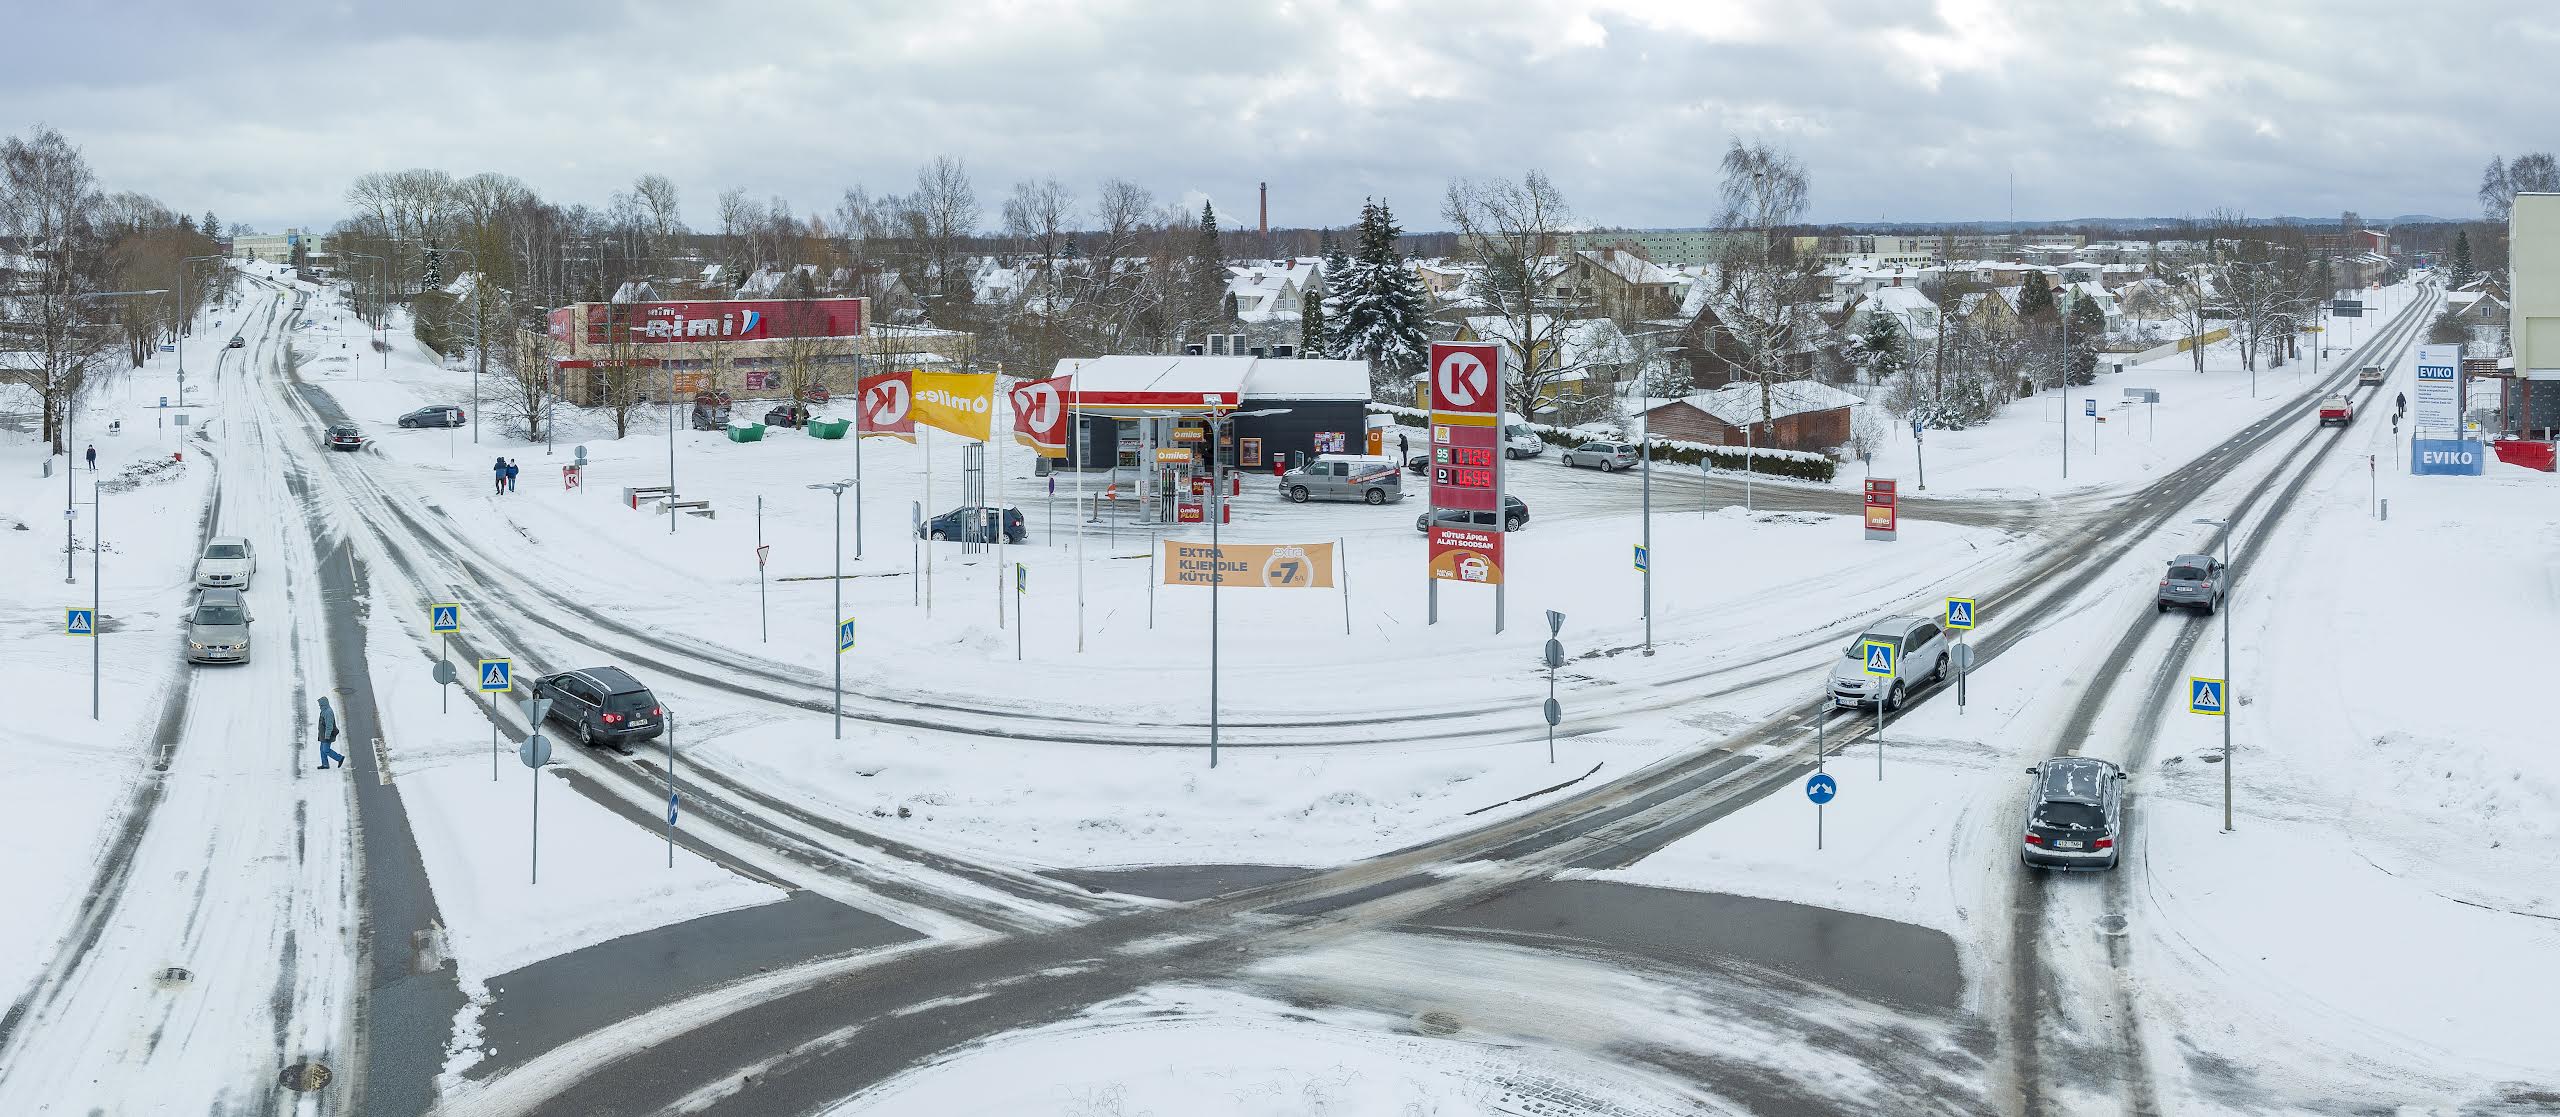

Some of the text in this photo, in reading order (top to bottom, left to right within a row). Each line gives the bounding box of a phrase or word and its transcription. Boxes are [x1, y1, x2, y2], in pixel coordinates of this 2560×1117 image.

[2420, 367, 2452, 378] EVIKO
[1451, 363, 1484, 405] K
[1165, 451, 1189, 460] miles
[1437, 449, 1449, 458] 95
[2423, 451, 2473, 465] EVIKO
[1438, 469, 1448, 479] D
[568, 476, 579, 487] K
[1441, 531, 1488, 542] KÜTUS ÄPIGA
[1437, 538, 1494, 550] ALATI SOODSAM
[1179, 547, 1224, 559] EXTRA
[1273, 547, 1304, 559] extra
[1179, 560, 1248, 572] KLIENDILE
[1179, 571, 1224, 583] KÜTUS
